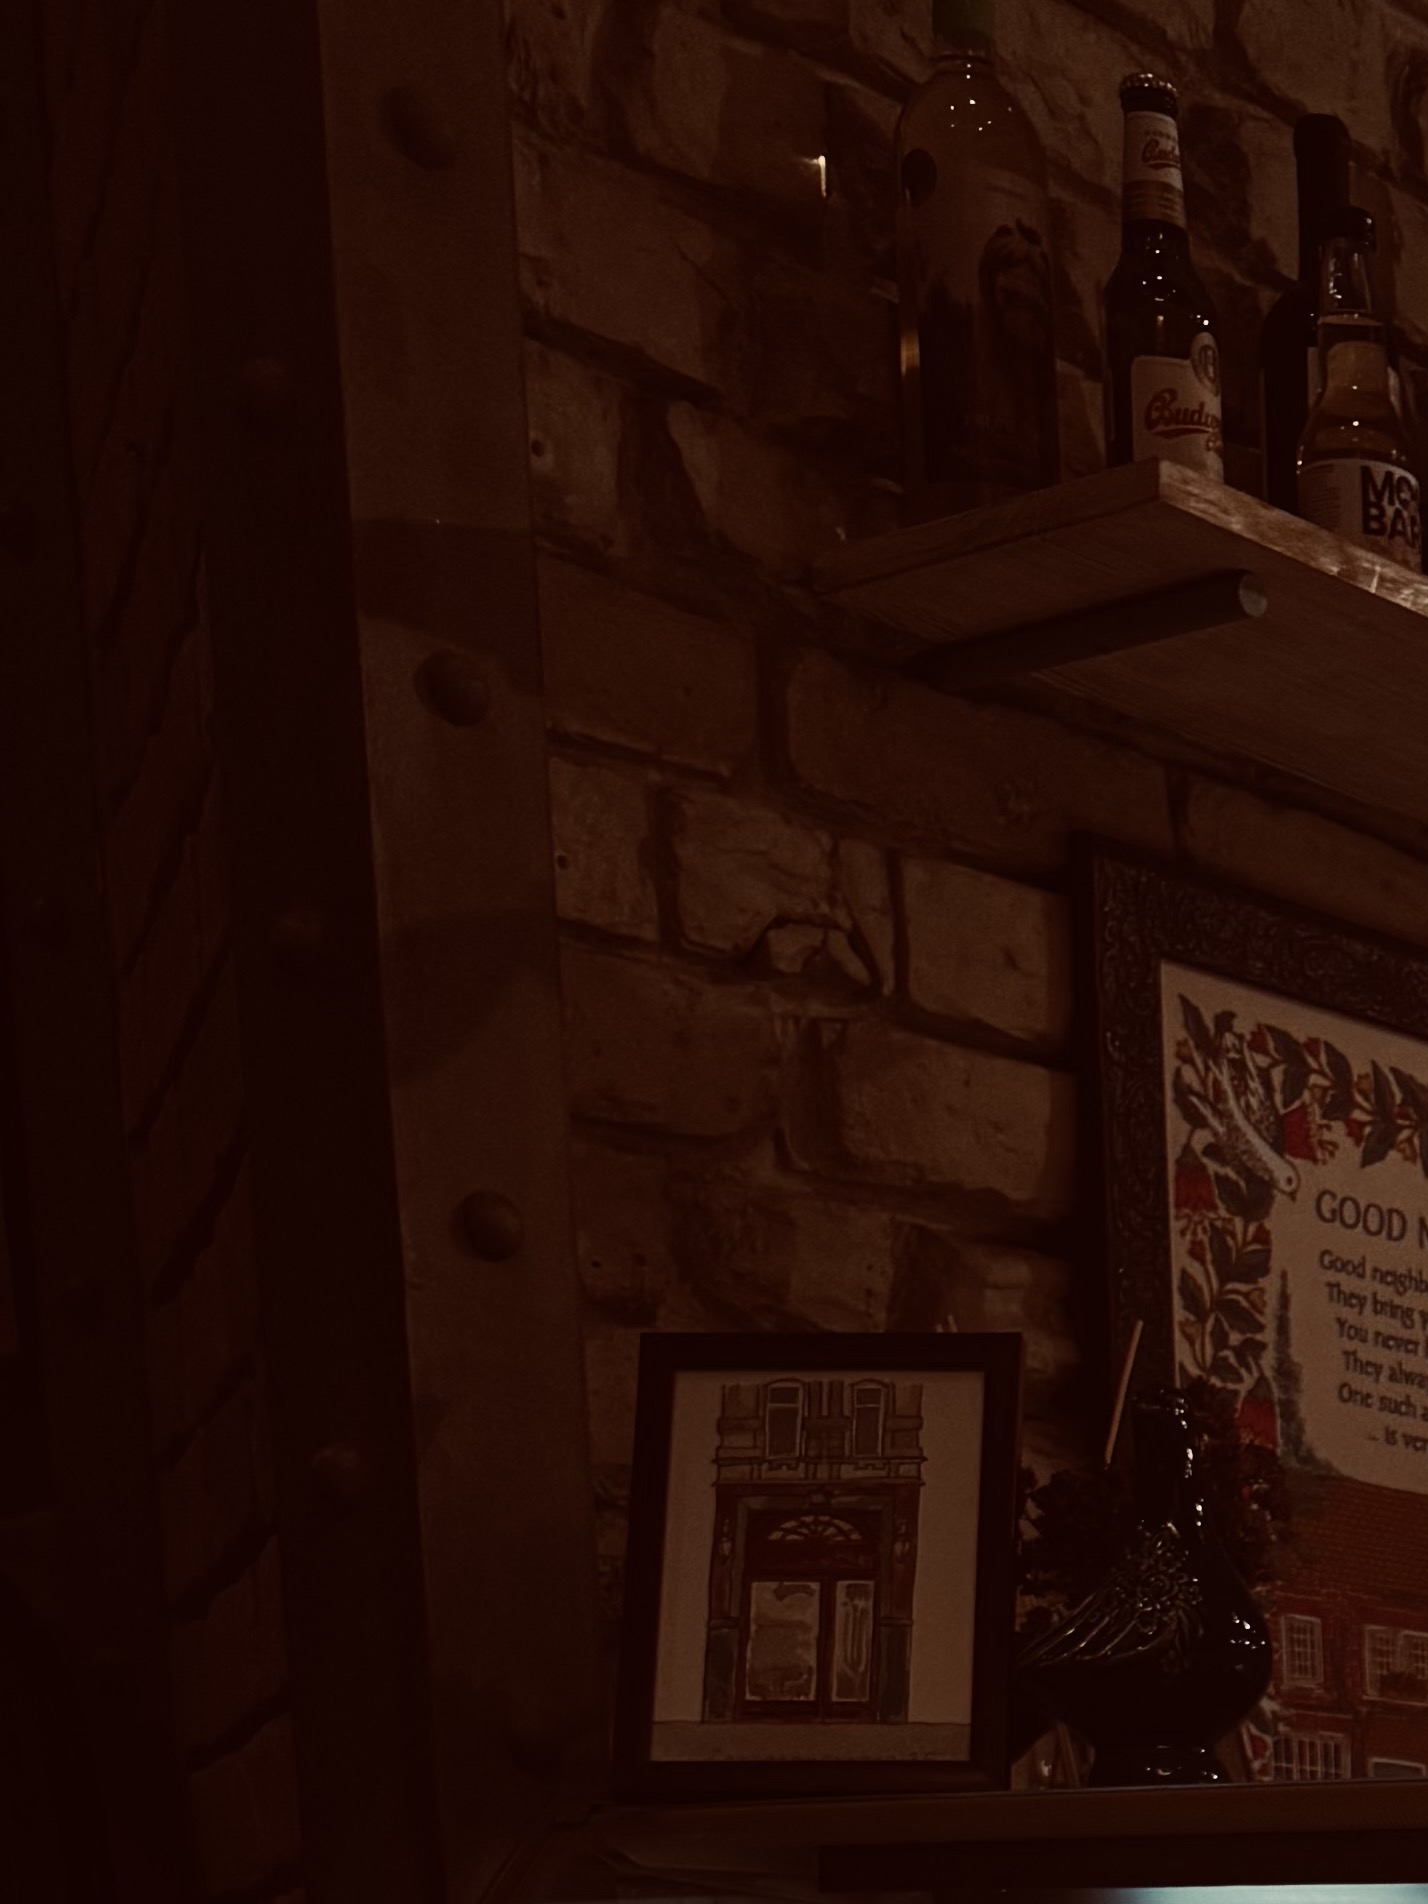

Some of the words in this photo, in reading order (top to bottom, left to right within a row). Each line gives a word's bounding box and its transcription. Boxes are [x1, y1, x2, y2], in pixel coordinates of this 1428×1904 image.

[1316, 1189, 1407, 1242] GOOD
[1320, 1250, 1366, 1278] Good
[1326, 1281, 1366, 1316] They
[1372, 1292, 1415, 1330] bring
[1336, 1317, 1369, 1344] You
[1374, 1330, 1420, 1354] never
[1342, 1350, 1384, 1384] They
[1337, 1382, 1373, 1409] One
[1378, 1395, 1417, 1420] such
[1384, 1425, 1397, 1446] is
